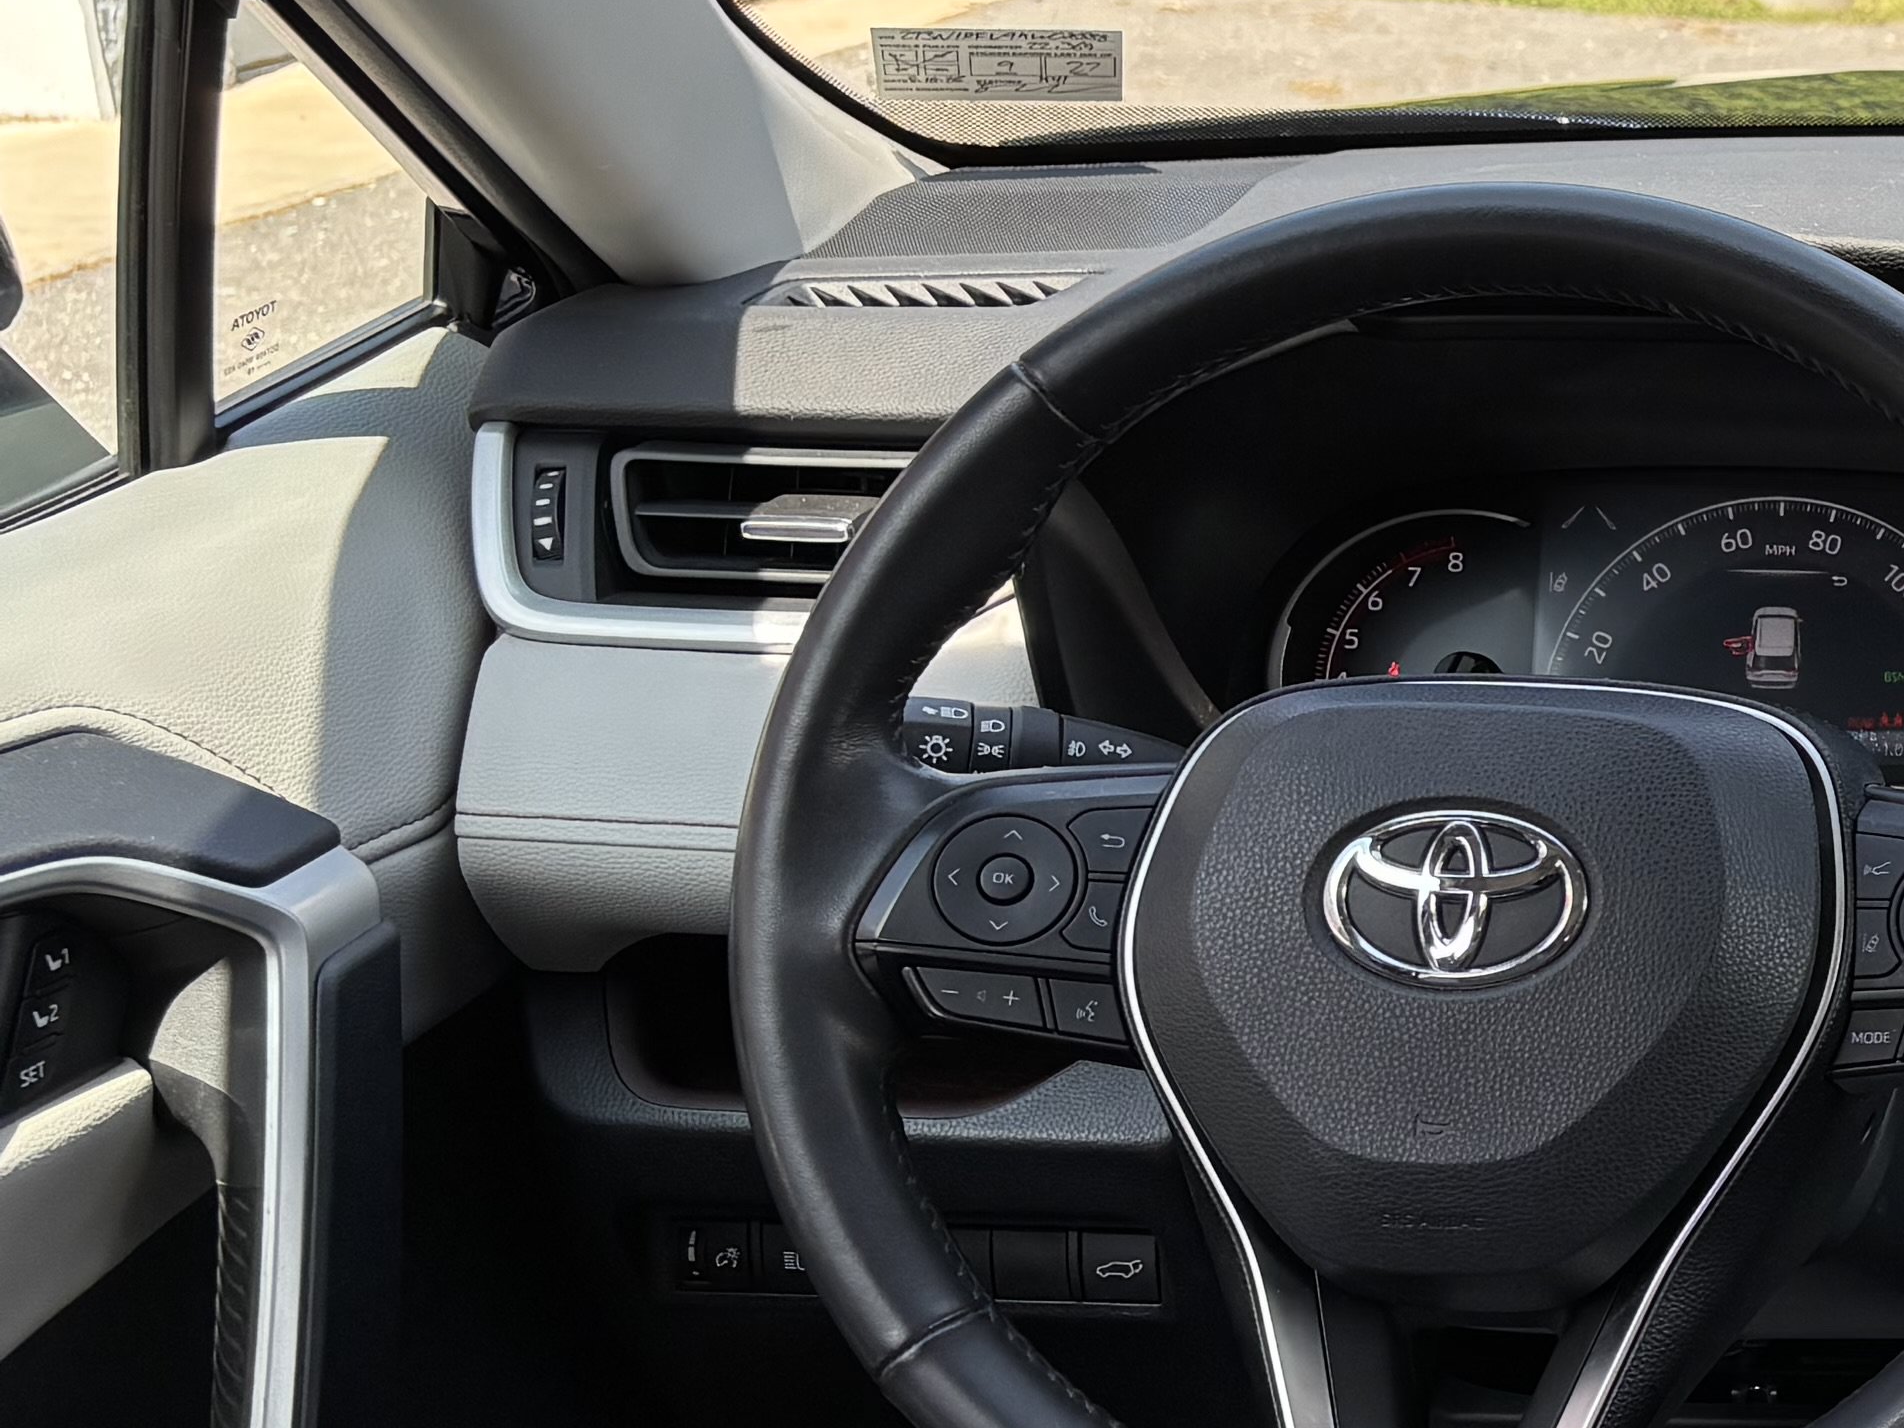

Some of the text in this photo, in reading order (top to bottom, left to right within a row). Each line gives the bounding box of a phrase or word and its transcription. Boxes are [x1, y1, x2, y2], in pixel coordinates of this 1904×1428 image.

[1721, 529, 1753, 553] 60
[1765, 545, 1796, 556] MPH
[1808, 530, 1842, 555] 80
[1448, 552, 1464, 573] 8
[1407, 567, 1423, 588] 7
[1642, 563, 1673, 593] 40
[1367, 593, 1384, 611] 6
[1344, 629, 1359, 650] 5
[1584, 631, 1613, 665] 20
[992, 872, 1014, 885] OK
[1851, 1030, 1891, 1045] MODE
[19, 1060, 46, 1088] SET
